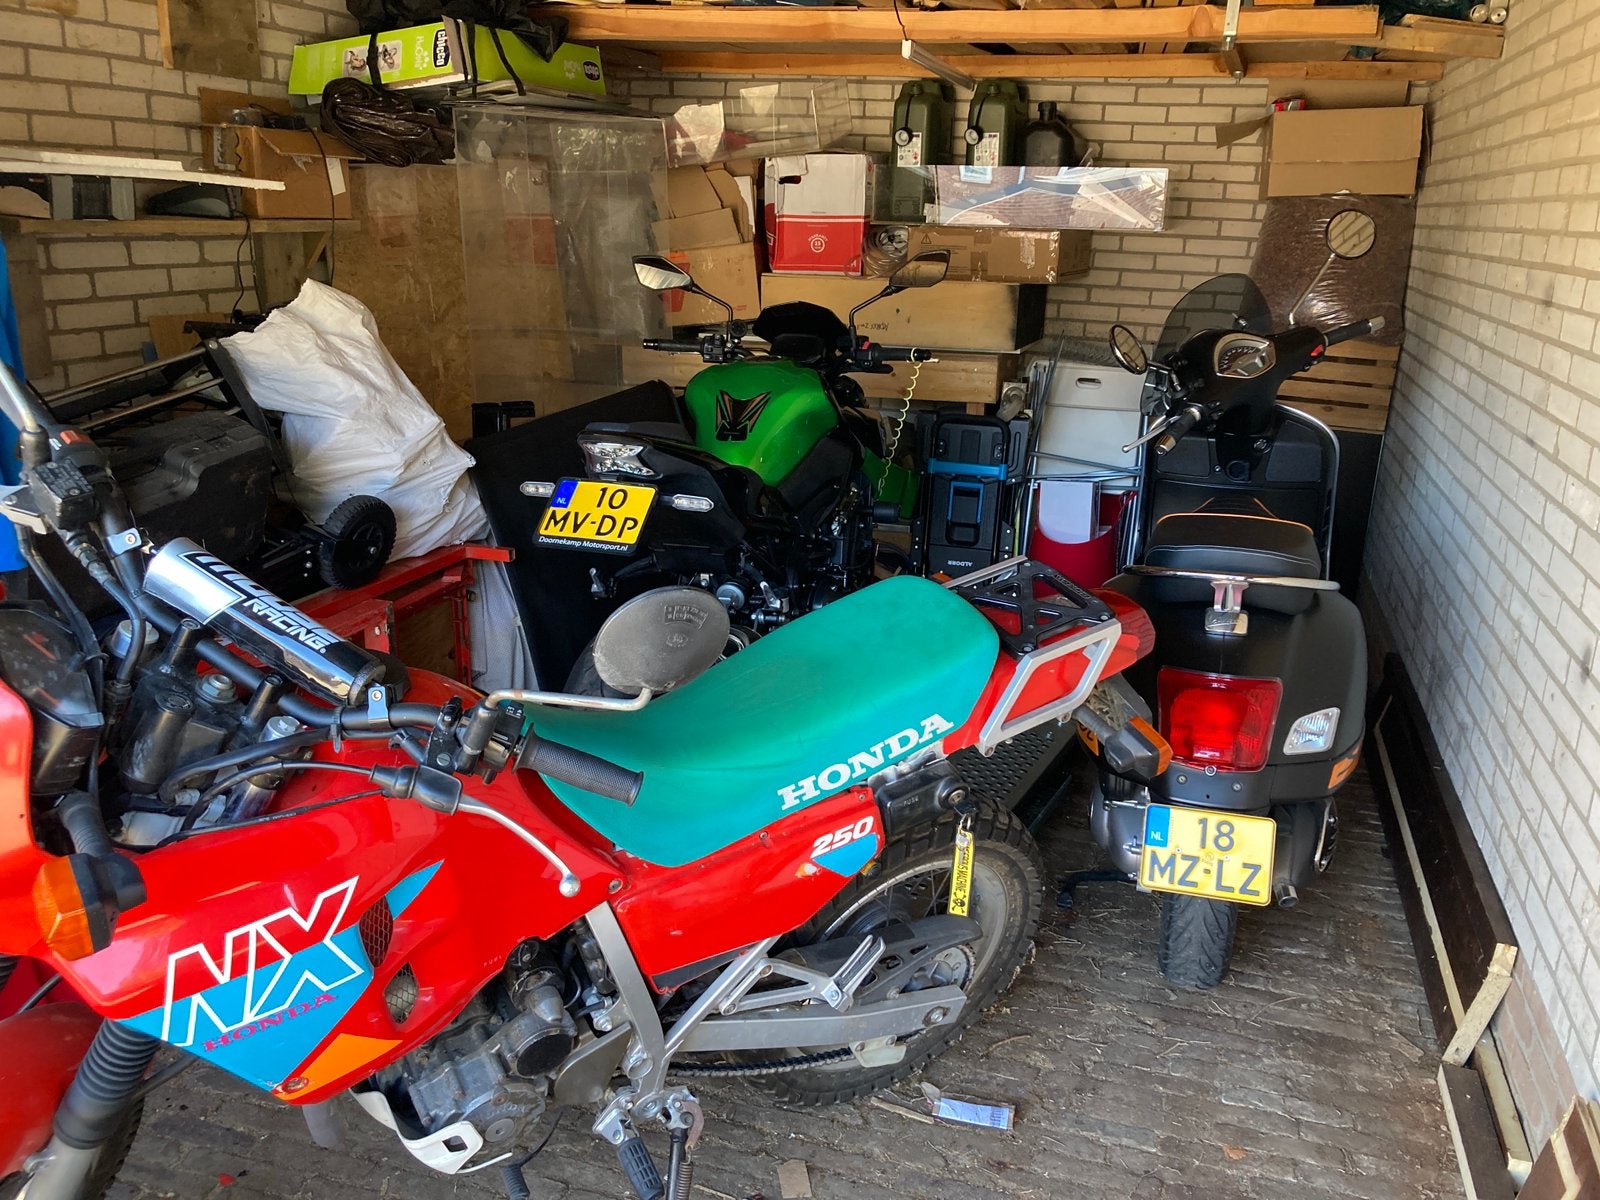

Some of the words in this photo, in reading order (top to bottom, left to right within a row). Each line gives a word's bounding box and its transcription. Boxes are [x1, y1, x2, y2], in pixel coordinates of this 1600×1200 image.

[436, 30, 447, 66] chicco
[596, 487, 628, 510] 10
[538, 535, 582, 547] Doornekamp
[582, 540, 628, 551] Motorsport.nl
[544, 510, 639, 538] MV-DP
[243, 597, 331, 650] RACING
[777, 713, 954, 811] HONDA
[810, 815, 874, 859] 250
[1151, 831, 1164, 841] NL
[1198, 817, 1234, 852] 18
[1148, 851, 1262, 896] MZ-LZ
[161, 875, 365, 1047] NX
[202, 993, 338, 1052] HONDA
